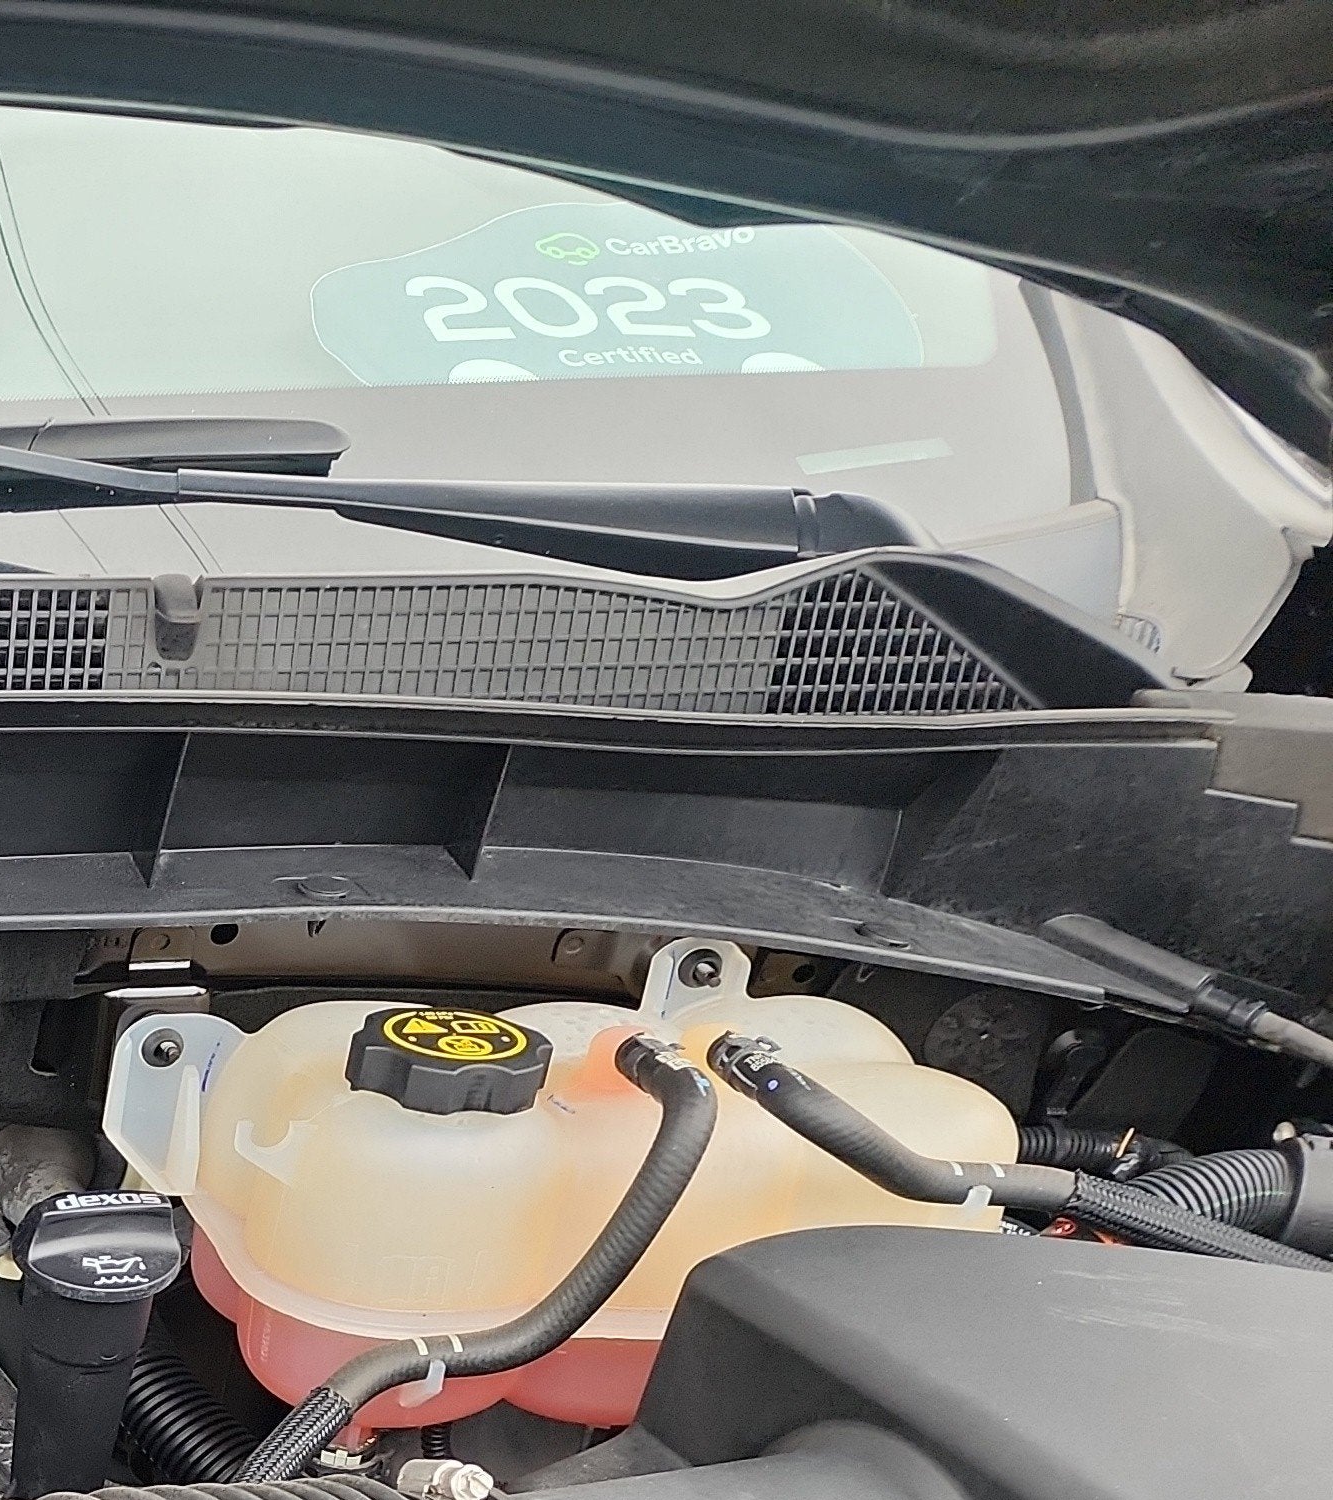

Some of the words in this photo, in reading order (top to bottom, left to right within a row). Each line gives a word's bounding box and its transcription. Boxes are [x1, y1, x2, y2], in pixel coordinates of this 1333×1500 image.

[606, 227, 756, 255] CarBravo
[406, 277, 771, 342] 2023
[558, 347, 703, 367] Certified
[55, 1193, 161, 1210] dexos
